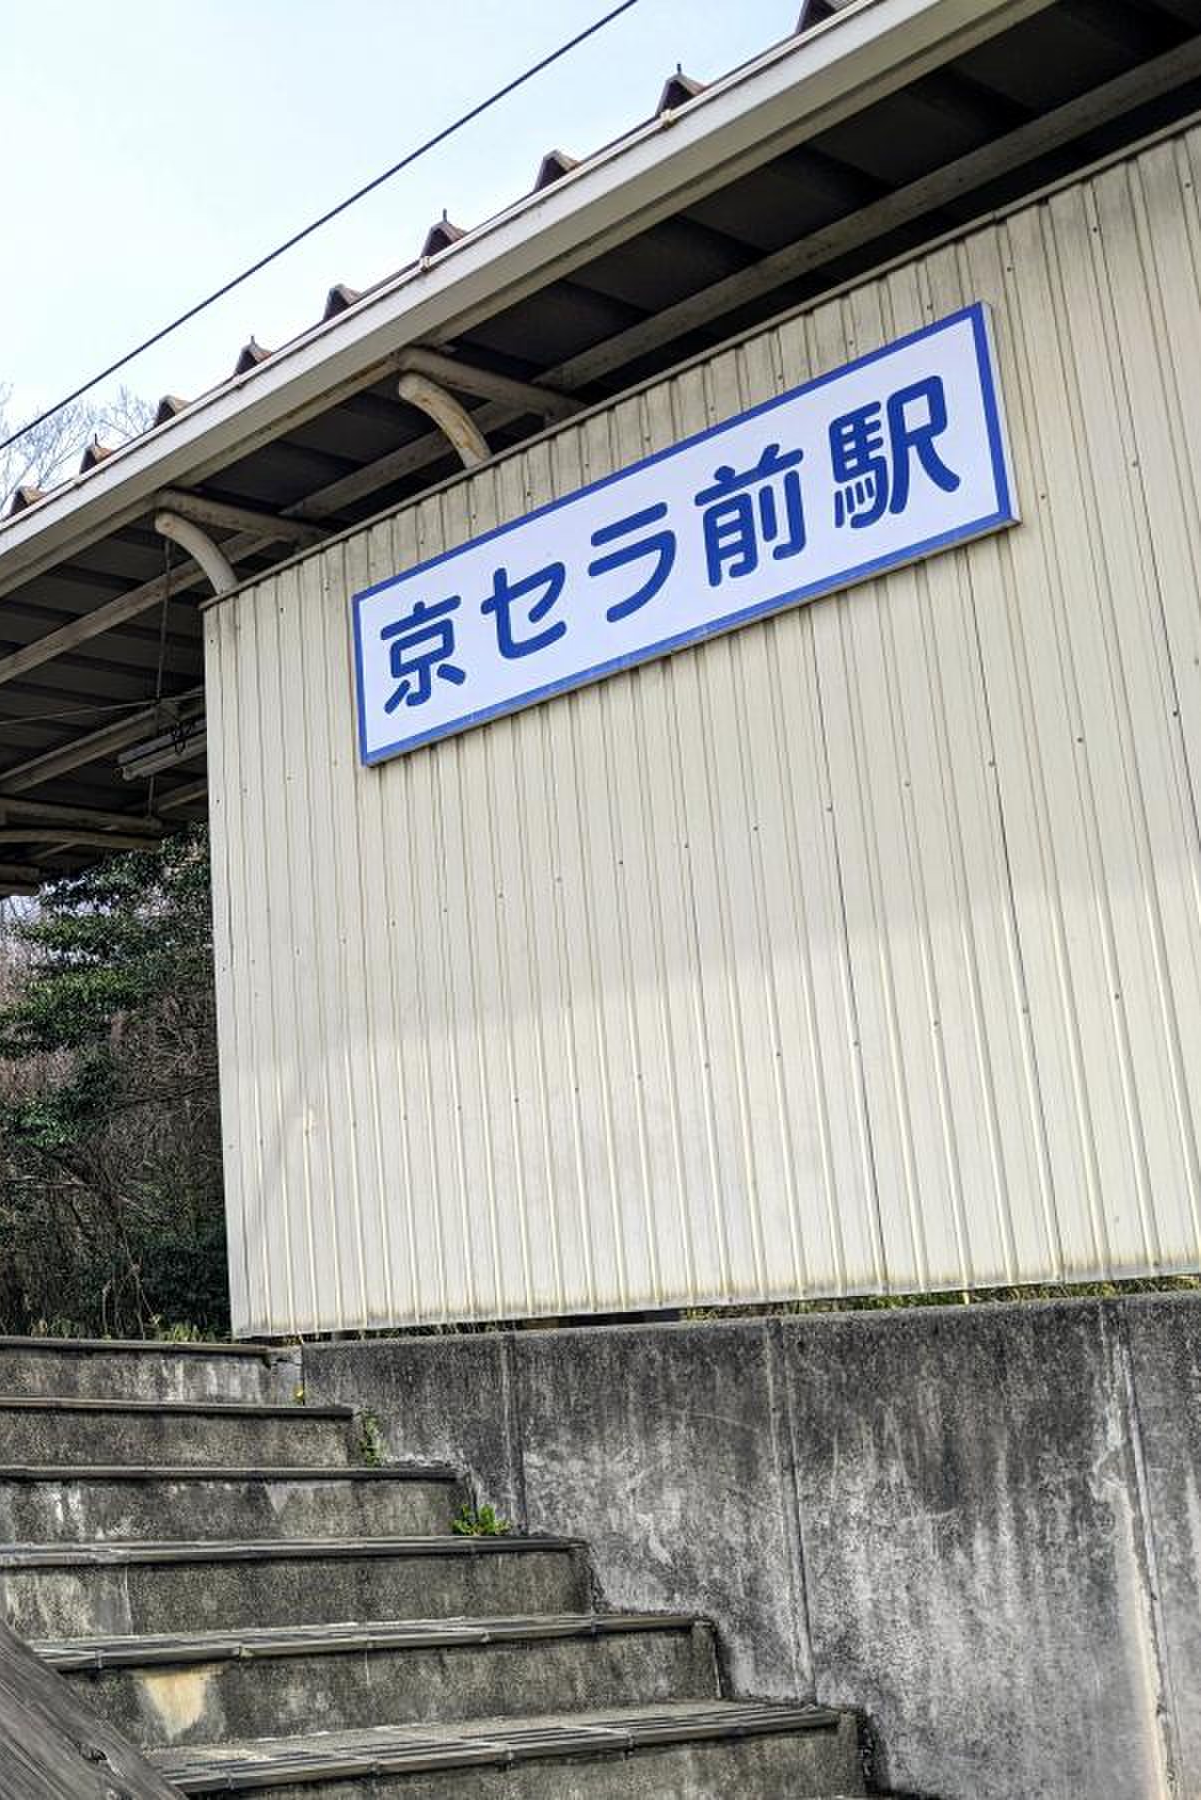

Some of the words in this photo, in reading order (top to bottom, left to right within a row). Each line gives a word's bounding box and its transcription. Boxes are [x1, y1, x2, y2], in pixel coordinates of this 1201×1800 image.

[380, 375, 960, 714] 京セラ前駅
